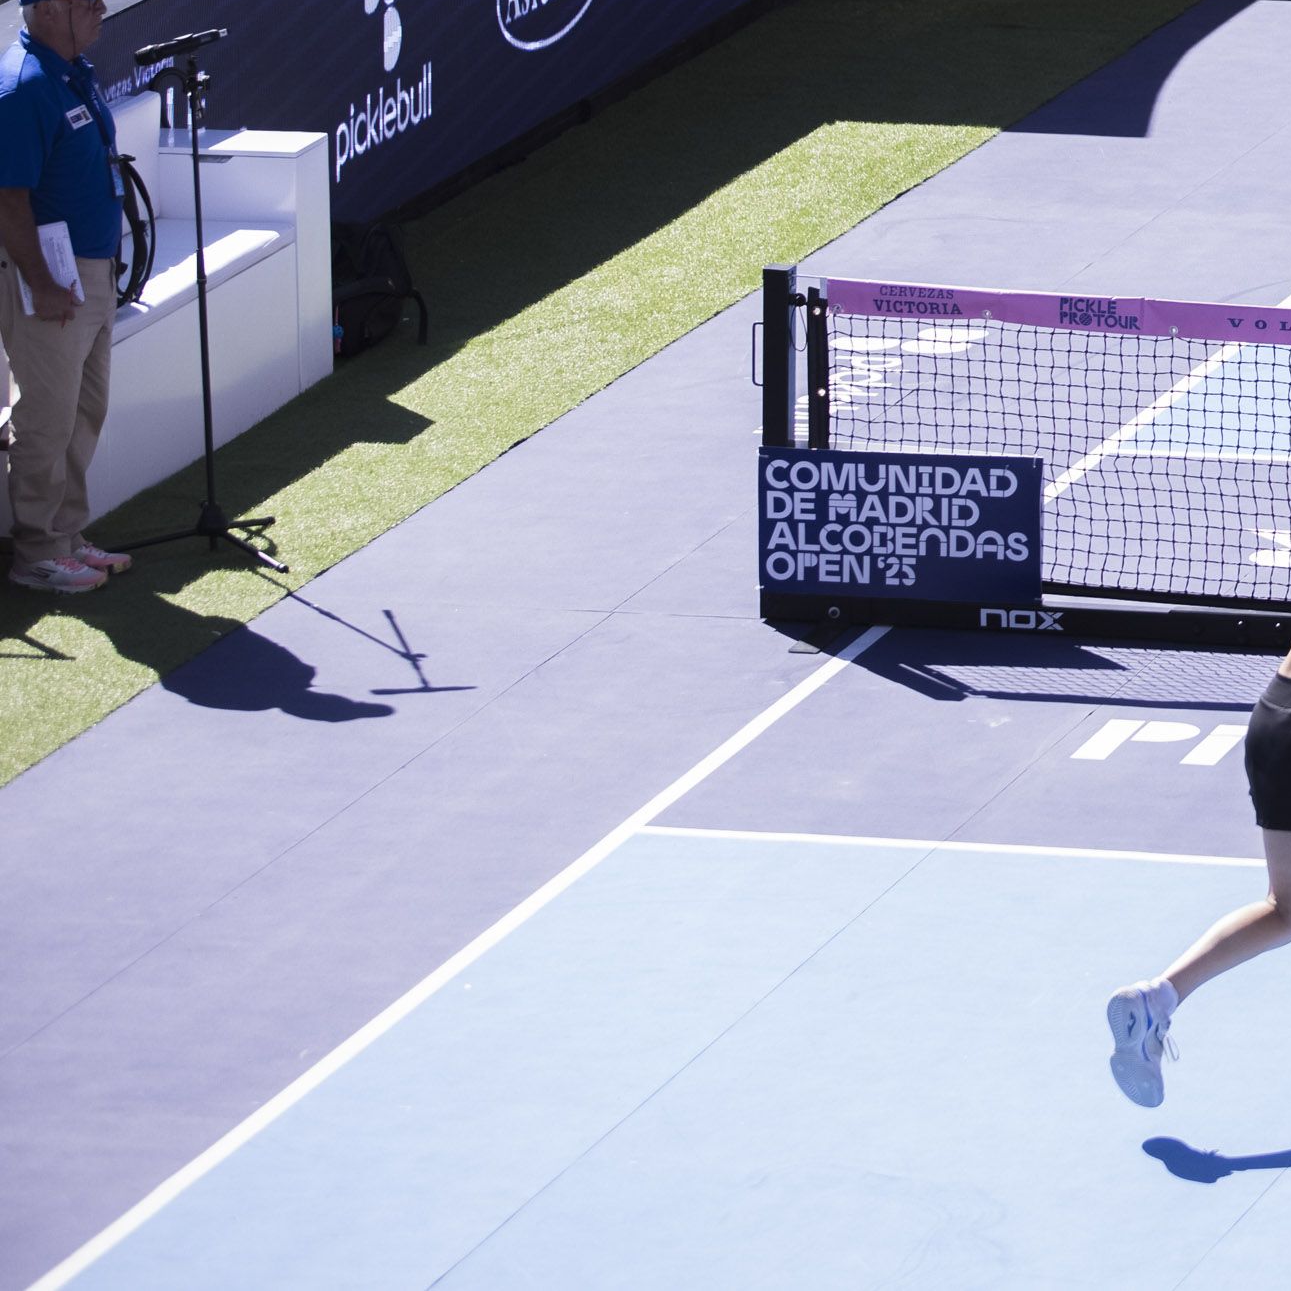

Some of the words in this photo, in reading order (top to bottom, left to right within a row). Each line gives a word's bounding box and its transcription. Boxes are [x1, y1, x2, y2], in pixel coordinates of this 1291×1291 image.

[336, 60, 432, 184] picklebull
[872, 298, 964, 316] VICTORIA
[879, 285, 955, 301] CERVEZAS
[1060, 298, 1117, 314] PICKLE
[765, 459, 1018, 498] COMUNIDAD
[766, 491, 817, 521] DE
[828, 493, 980, 527] MADRID
[766, 521, 1029, 562] ALCOBENDAS
[765, 552, 870, 584] OPEN
